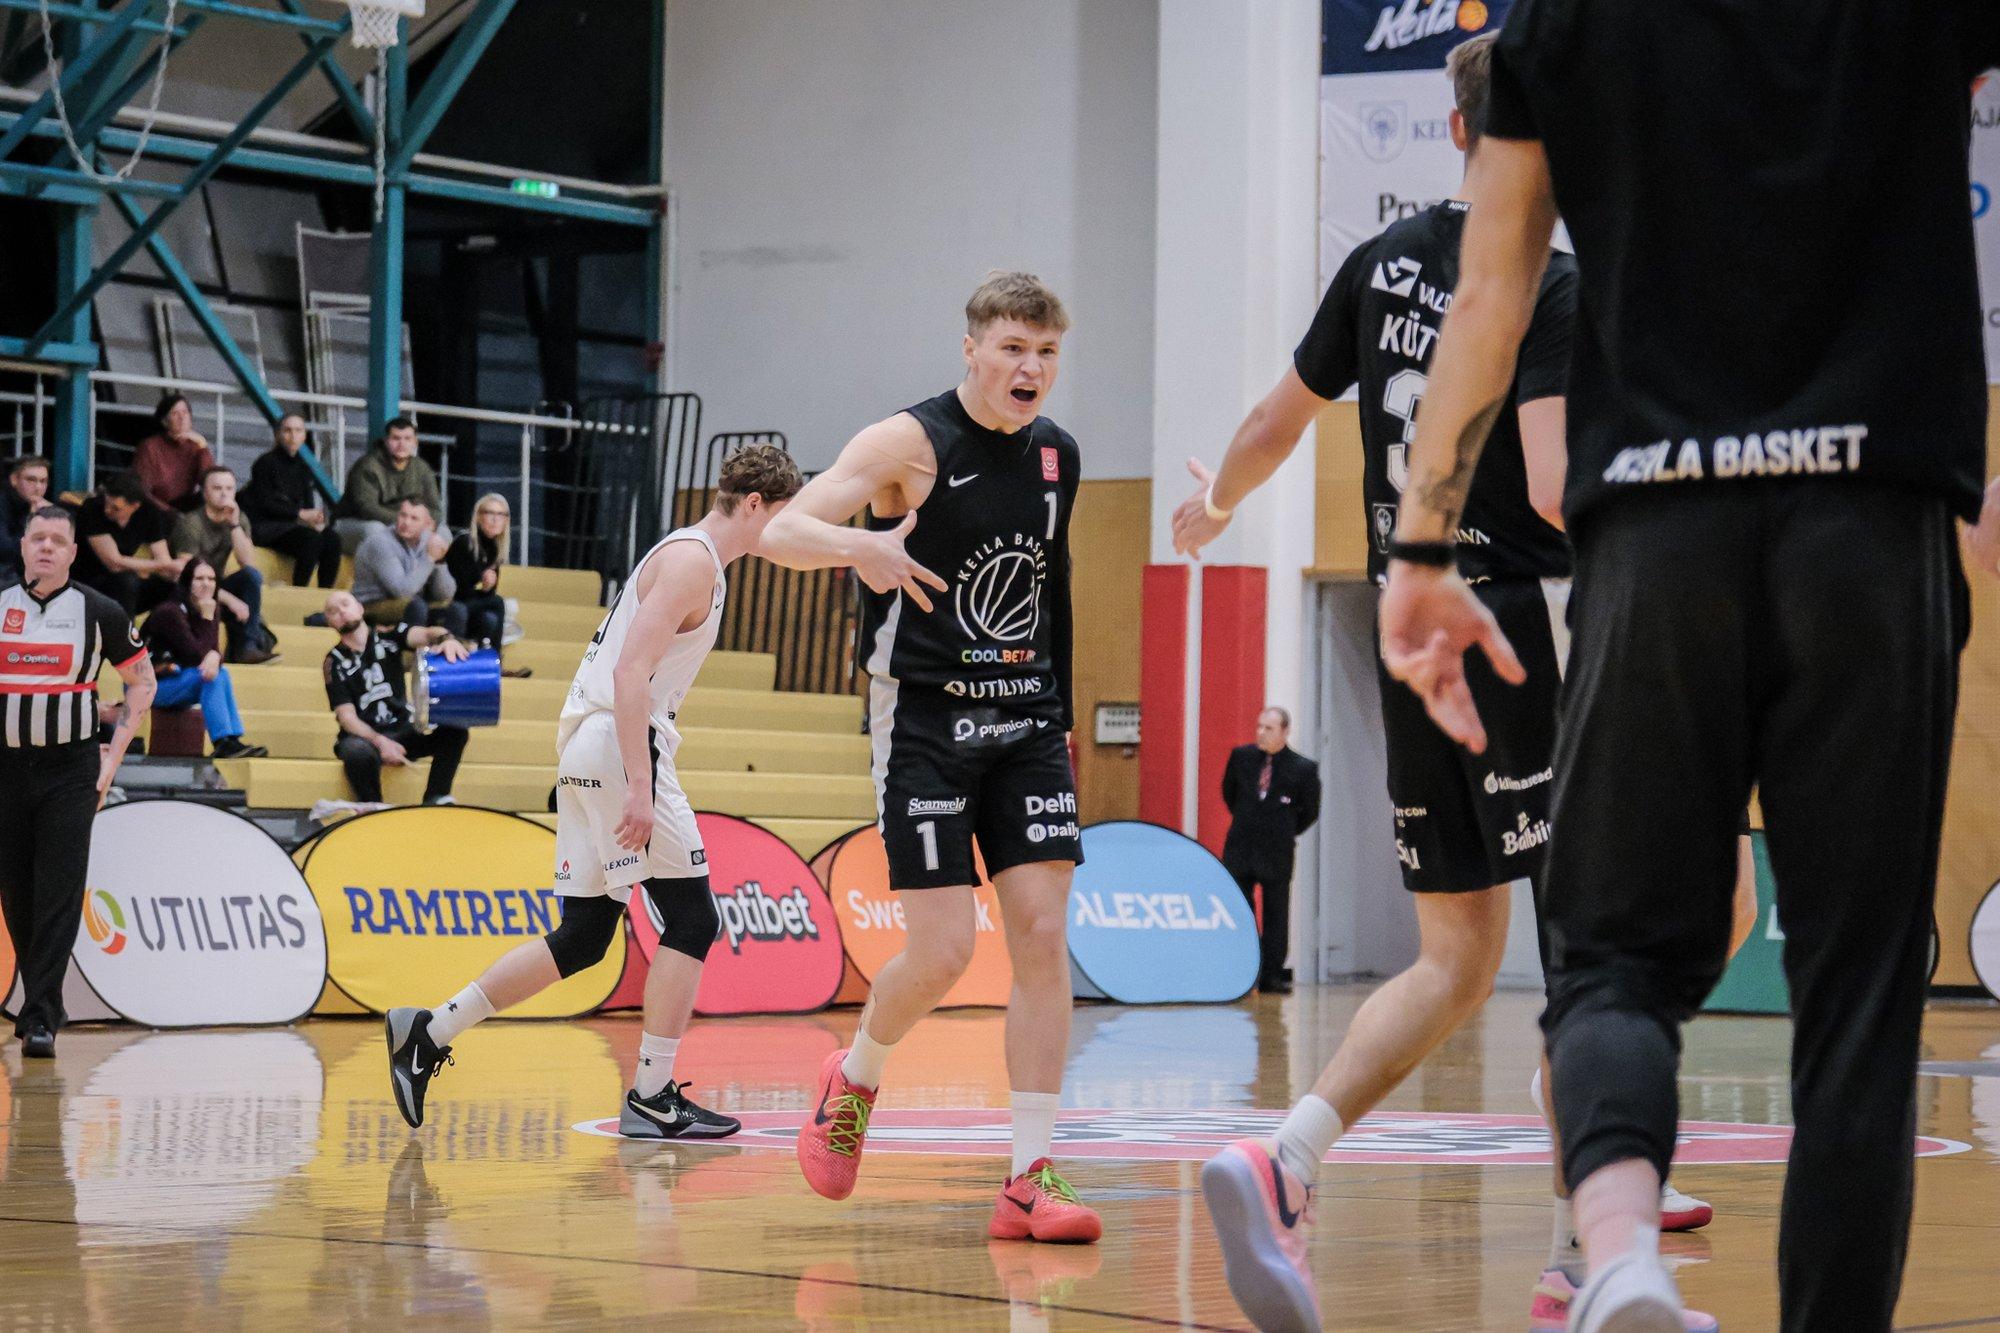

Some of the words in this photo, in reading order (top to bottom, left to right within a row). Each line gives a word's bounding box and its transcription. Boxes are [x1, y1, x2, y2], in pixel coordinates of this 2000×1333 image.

[1364, 0, 1458, 51] Keila
[1411, 119, 1448, 140] KEI
[1448, 201, 1471, 211] NIKE
[1378, 310, 1439, 361] KÜT
[1713, 424, 1868, 479] BASKET
[1045, 491, 1057, 539] 1
[957, 536, 1004, 582] KEILA
[1014, 533, 1047, 580] BASKET
[969, 677, 1042, 698] UTILITAS
[979, 718, 1034, 738] prysmian
[907, 797, 966, 812] Scanweld
[1025, 792, 1076, 816] Delfi
[916, 820, 940, 871] 1
[1048, 821, 1079, 841] Daily
[1501, 819, 1553, 855] Balbii
[131, 894, 305, 951] UTILITAS
[711, 879, 820, 955] ptibet
[847, 889, 995, 932] Swek
[1073, 890, 1238, 931] ALEXELA
